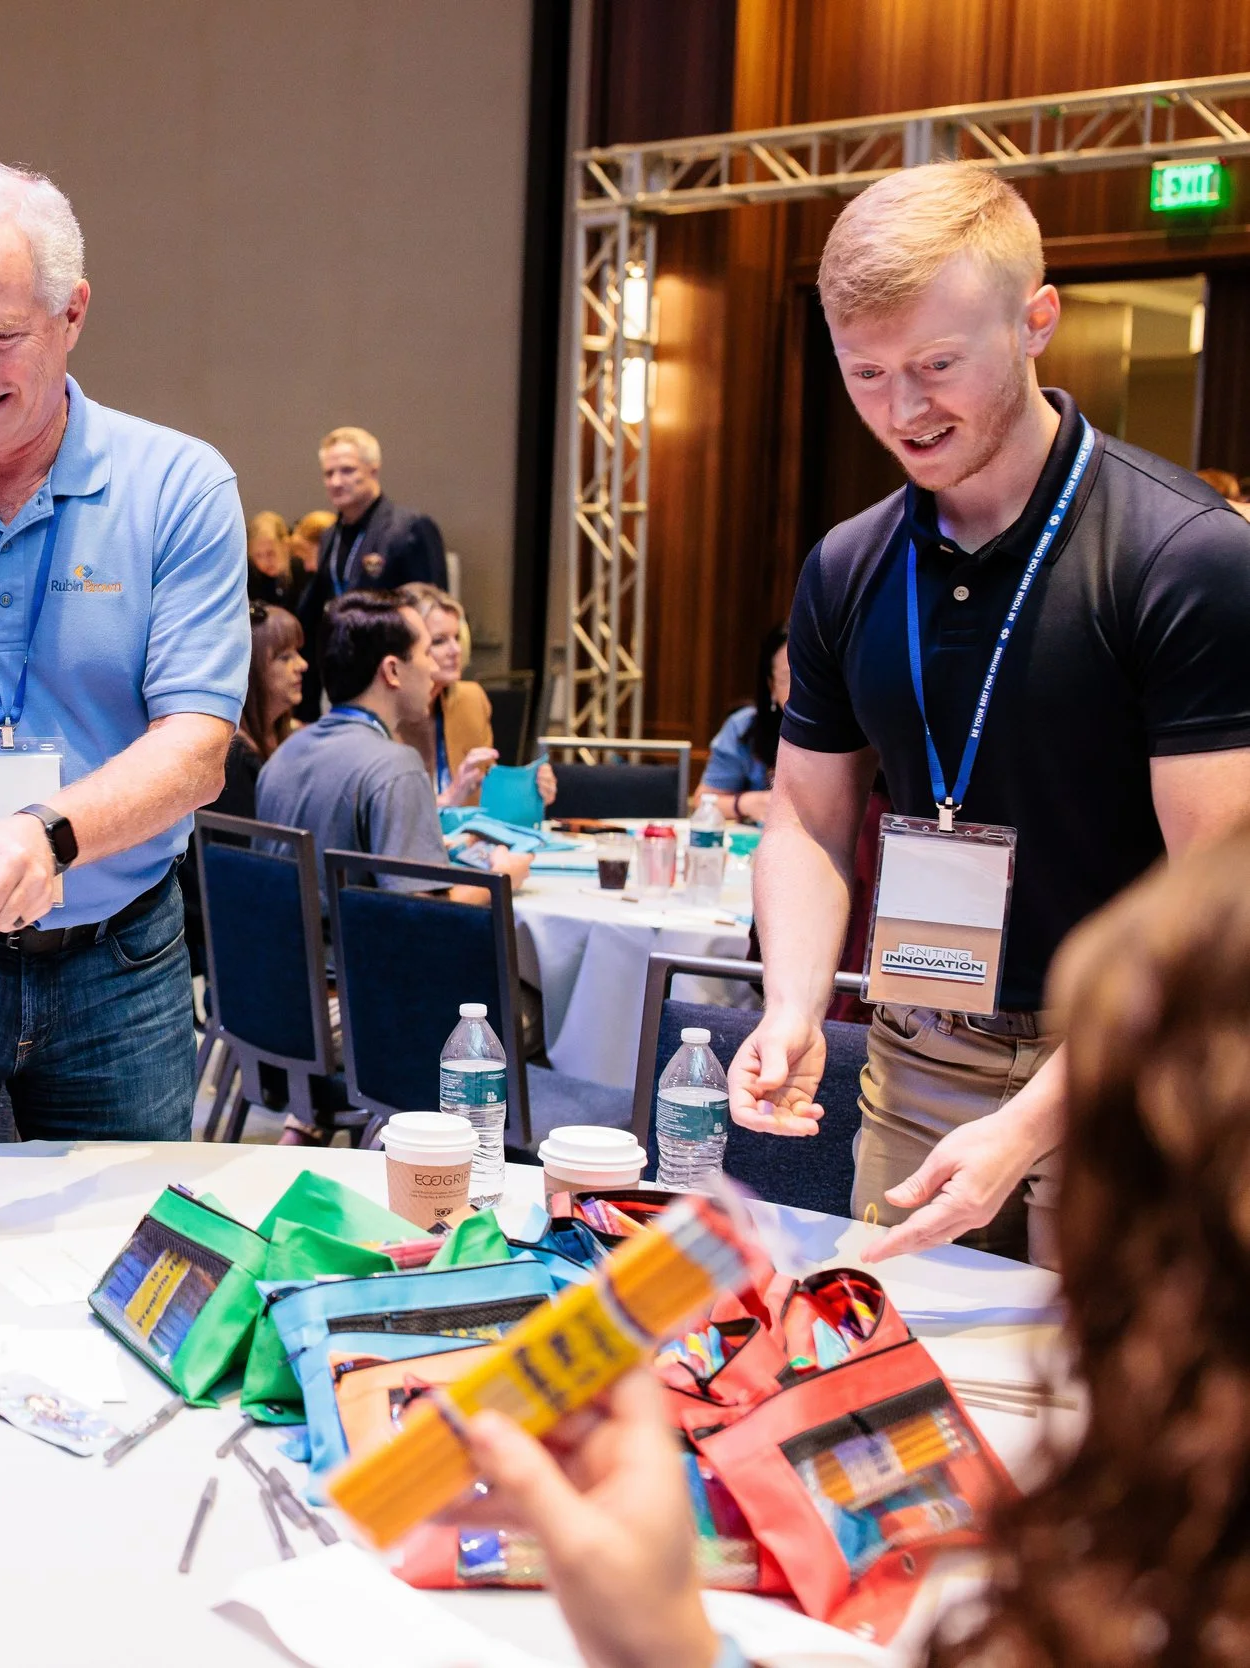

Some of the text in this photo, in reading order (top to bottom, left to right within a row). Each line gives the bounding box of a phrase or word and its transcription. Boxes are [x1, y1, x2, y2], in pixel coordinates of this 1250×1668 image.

[1163, 165, 1214, 207] EXIT
[1078, 451, 1089, 465] FOR
[1071, 465, 1083, 481] BEST
[1062, 480, 1076, 499] YOUR
[1058, 500, 1067, 509] BE
[1007, 532, 1052, 621] BE YOUR BEST FOR OTHERS
[51, 579, 122, 592] RubinBrown
[971, 647, 1003, 738] BE YOUR BEST FOR OTHERS
[901, 945, 969, 961] IGNITING
[885, 953, 983, 972] INNOVATION
